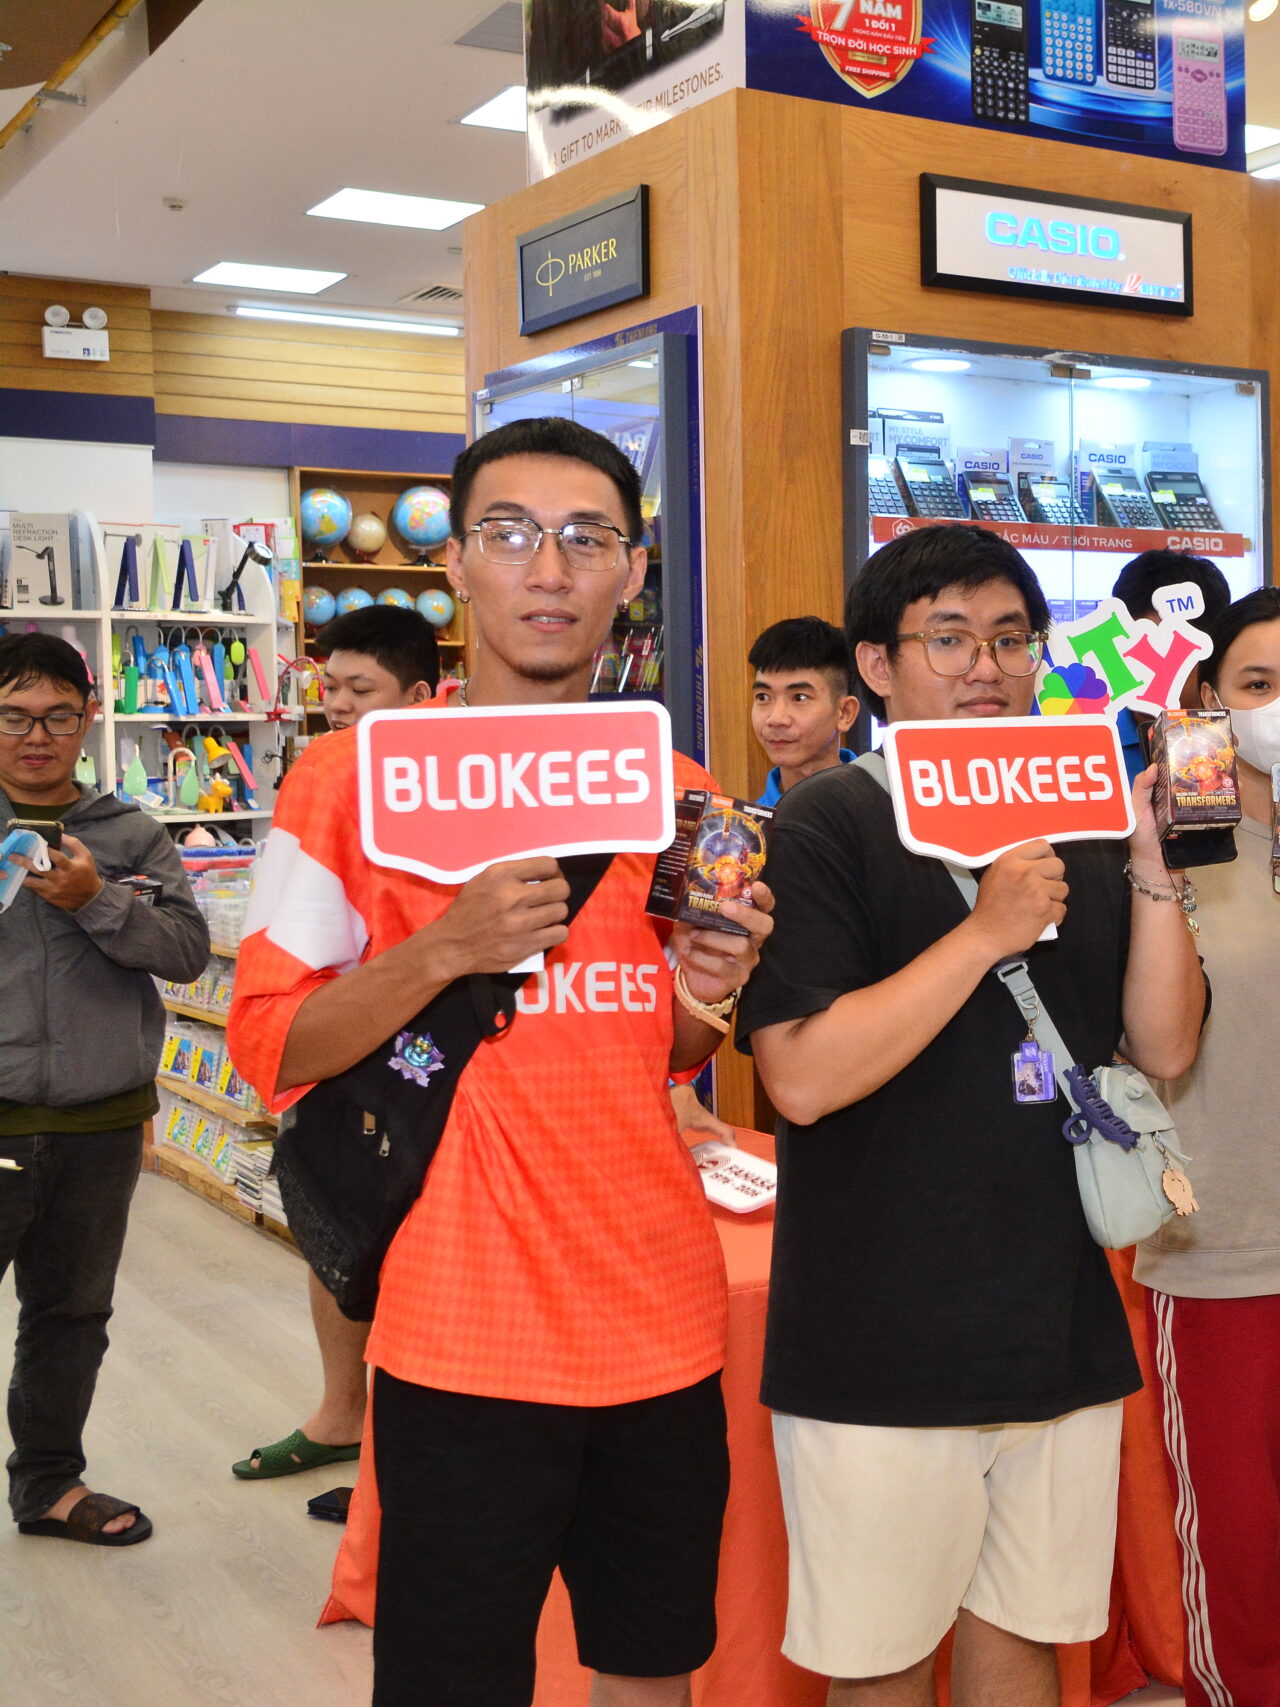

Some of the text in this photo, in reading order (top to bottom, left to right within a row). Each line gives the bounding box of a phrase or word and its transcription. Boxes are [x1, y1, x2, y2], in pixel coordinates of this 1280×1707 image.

[816, 31, 917, 56] TRỌN ĐỜI HỌC SINH
[845, 65, 891, 79] FREE SHIPPING
[560, 140, 580, 164] GIFT
[582, 135, 593, 151] TO
[595, 119, 622, 141] MARK
[655, 63, 723, 112] MILESTONES.
[985, 211, 1121, 261] CASIO
[568, 238, 618, 275] PARKER
[1008, 266, 1051, 286] Officially
[1054, 272, 1108, 291] Distributed
[889, 435, 907, 444] MY
[908, 435, 949, 448] COMFORT
[964, 461, 1000, 471] CASIO
[1021, 452, 1044, 461] CASIO
[1088, 453, 1127, 465] CASIO
[997, 532, 1019, 543] ẮC
[1022, 532, 1050, 544] MÀU
[1094, 537, 1133, 548] TRANG
[1167, 536, 1223, 551] CASIO
[1166, 595, 1195, 613] TM
[383, 748, 650, 813] BLOKEES
[909, 755, 1114, 807] BLOKEES
[1175, 795, 1237, 807] TRANSFORMERS
[688, 895, 720, 912] TRANSF
[515, 961, 659, 1015] OKEES
